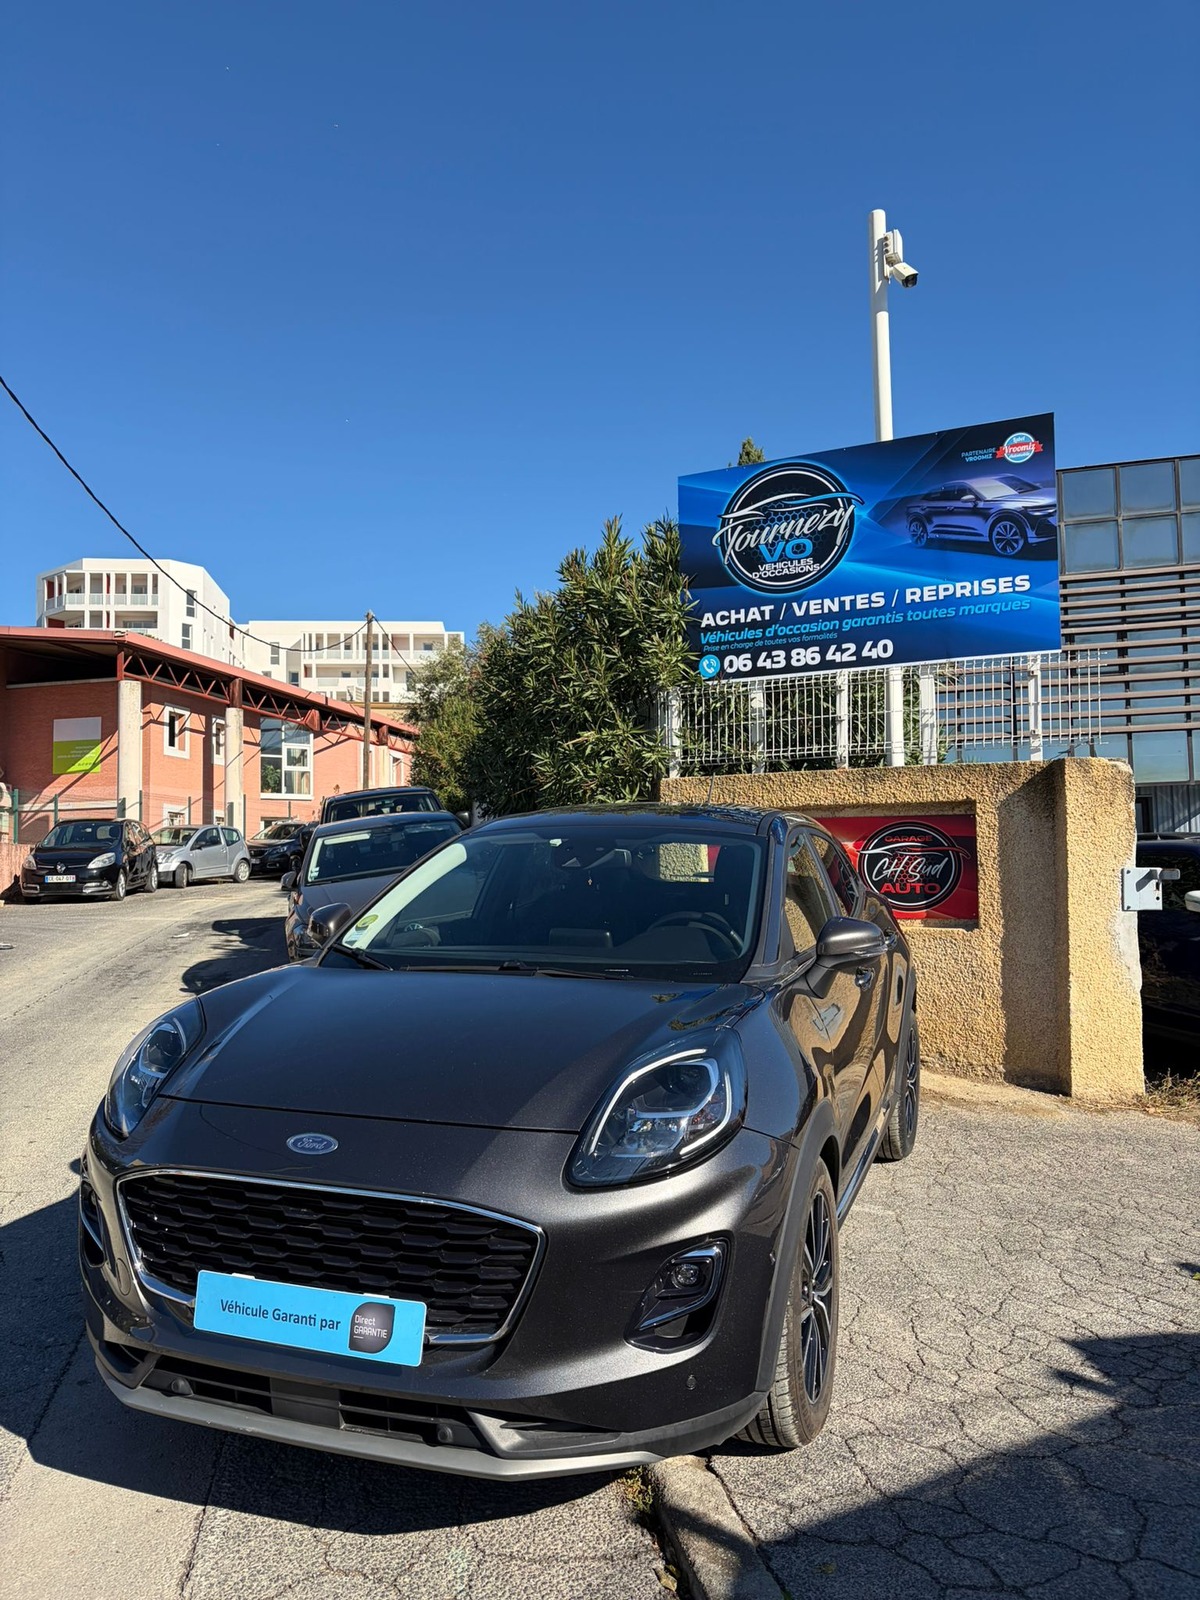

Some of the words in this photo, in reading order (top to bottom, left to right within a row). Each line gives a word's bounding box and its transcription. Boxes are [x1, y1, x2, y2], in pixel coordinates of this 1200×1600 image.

[961, 447, 996, 457] PARTENAIRE
[1002, 441, 1036, 455] Vroomiz
[965, 453, 993, 463] VROOMIZ
[712, 507, 856, 565] Tournezy
[759, 538, 813, 562] VO
[752, 563, 820, 579] D'OCCASIONS
[758, 557, 814, 571] VEHICULES
[701, 605, 774, 627] ACHAT
[792, 593, 885, 616] VENTES
[905, 574, 1031, 604] REPRISES
[700, 627, 763, 645] Véhicules
[765, 618, 839, 637] d'occasion
[842, 610, 904, 632] garantis
[906, 606, 956, 622] toutes
[958, 599, 1030, 616] marques
[703, 645, 720, 653] Prise
[720, 643, 730, 651] en
[730, 640, 753, 652] charge
[754, 639, 764, 647] de
[764, 637, 787, 646] toutes
[801, 631, 838, 642] formalités
[723, 653, 753, 674] 06
[756, 649, 787, 670] 43
[790, 646, 821, 667] 86
[825, 642, 857, 663] 42
[861, 638, 894, 660] 40
[907, 856, 949, 883] Sud
[880, 883, 940, 894] AUTO
[297, 1137, 328, 1150] Ford
[220, 1299, 269, 1319] Véhicule
[272, 1308, 317, 1327] Garanti
[319, 1316, 341, 1331] par
[354, 1314, 376, 1327] Direct
[353, 1325, 387, 1338] GARANTIE
